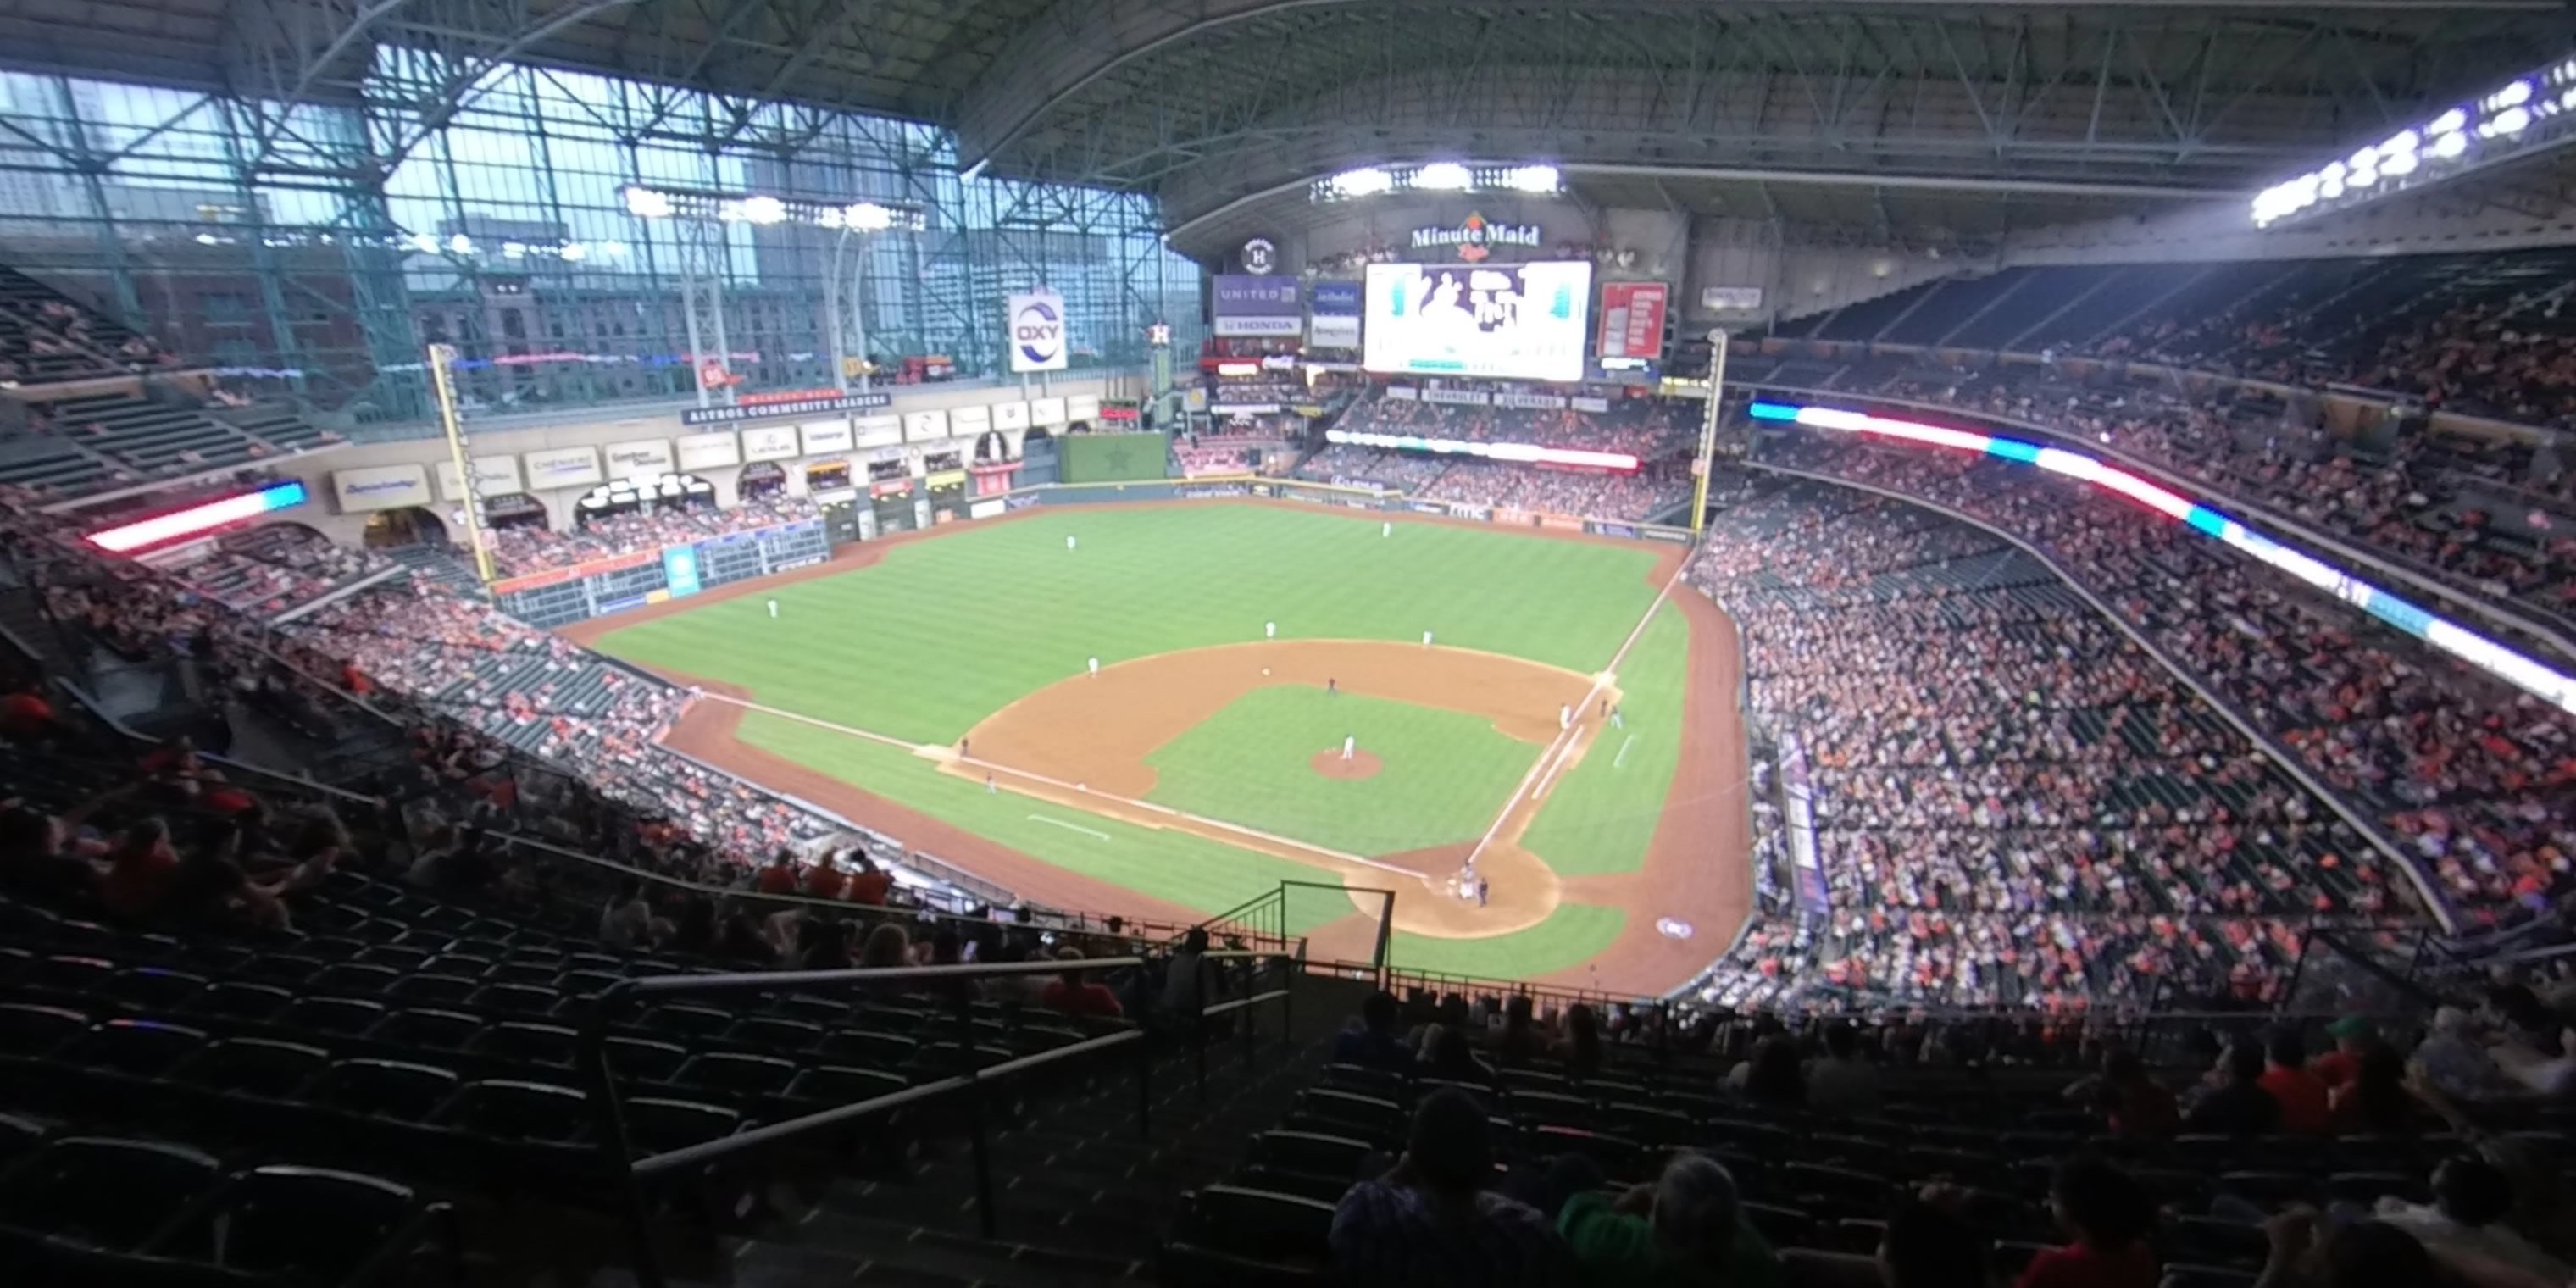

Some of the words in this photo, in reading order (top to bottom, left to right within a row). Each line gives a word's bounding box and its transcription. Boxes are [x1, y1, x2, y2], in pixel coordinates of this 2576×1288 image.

[1411, 226, 1482, 248] Minute
[1485, 223, 1541, 247] Maid
[1219, 289, 1279, 301] UNITED
[1237, 320, 1293, 330] HONDA
[1017, 325, 1059, 341] OXY
[1429, 390, 1482, 403] CHEVROLET
[690, 407, 745, 422] ASTROS
[747, 400, 830, 417] COMMUNITY
[834, 395, 887, 409] LEADERS
